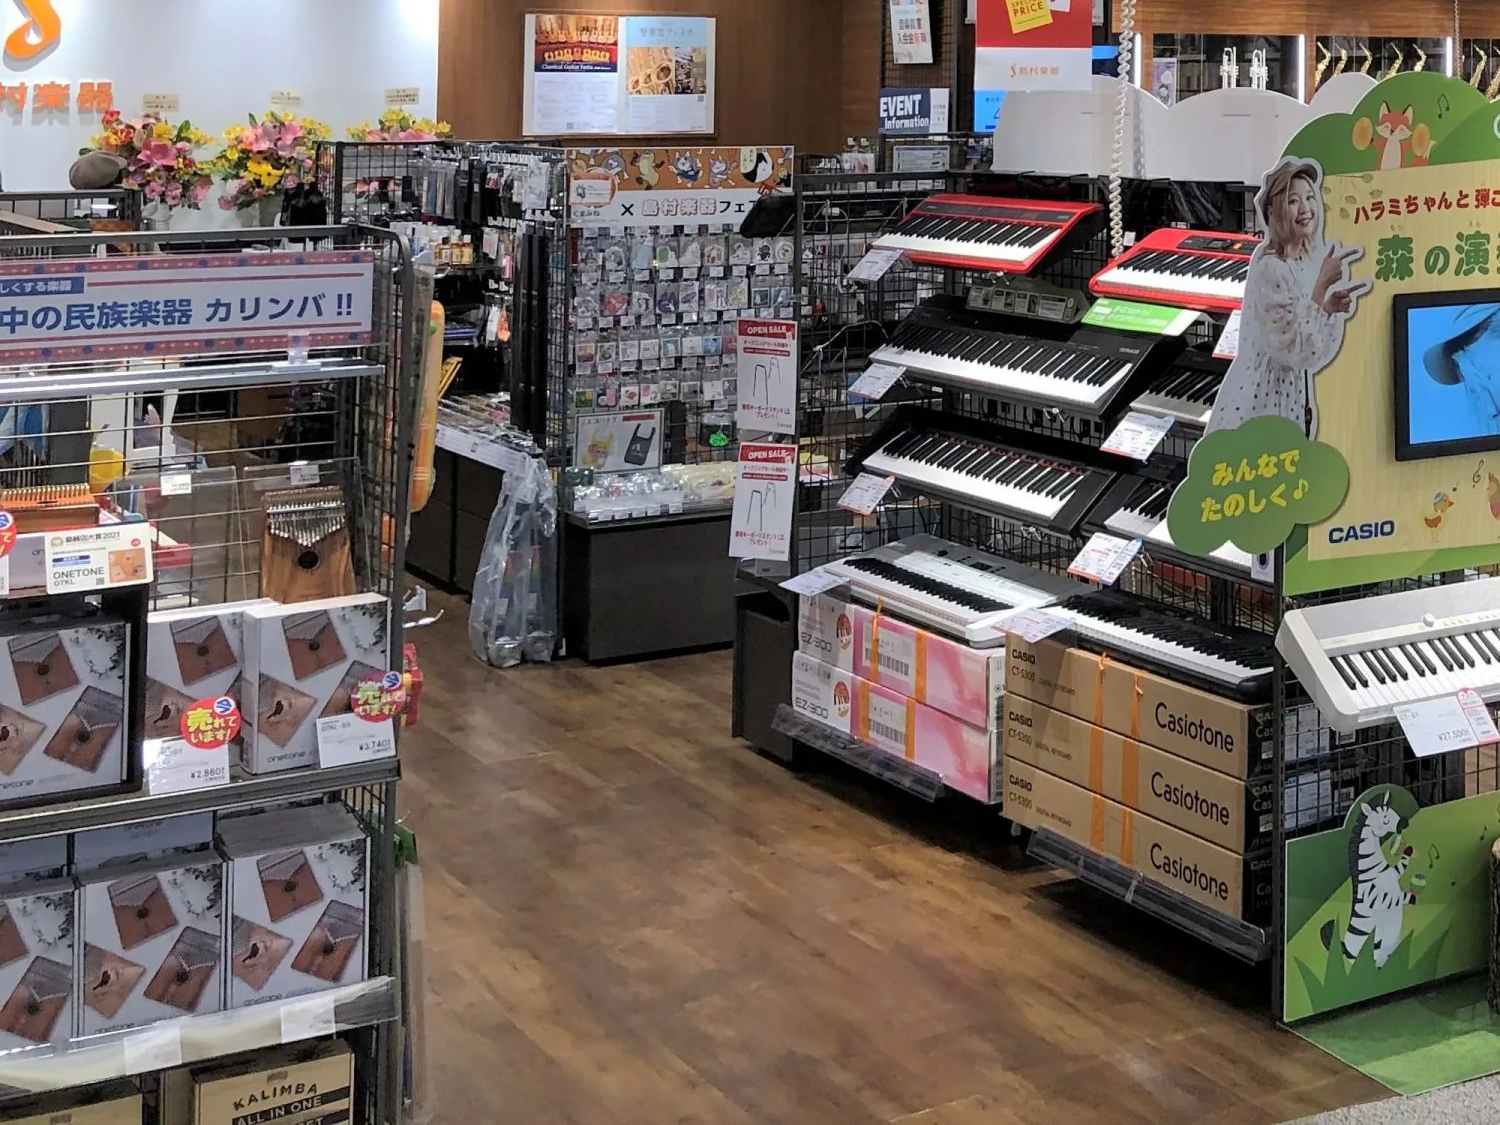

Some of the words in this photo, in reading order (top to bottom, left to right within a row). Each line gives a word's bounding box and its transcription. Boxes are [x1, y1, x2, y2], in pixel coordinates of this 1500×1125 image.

[1013, 1, 1044, 17] PRICE
[880, 94, 922, 117] EVENT
[884, 116, 930, 130] Information
[0, 299, 192, 334] 中の民族楽器
[206, 293, 326, 323] カリンバ
[747, 326, 768, 334] OPEN
[769, 325, 787, 334] SALE
[748, 451, 768, 460] OPEN
[768, 449, 789, 458] SALE
[1212, 449, 1300, 487] みんなで
[1327, 520, 1395, 544] CASIO
[53, 567, 105, 579] ONETONE
[801, 631, 833, 653] EZ-300
[1011, 648, 1036, 665] CASIO
[186, 707, 238, 732] 売れて
[795, 697, 829, 720] EZ-300
[1009, 711, 1033, 728] CASIO
[1155, 702, 1234, 753] Casiotone
[1009, 774, 1033, 792] CASIO
[1151, 771, 1230, 825] Casiotone
[1150, 842, 1229, 901] Casiotone
[232, 1083, 318, 1112] KALIMBA
[270, 1107, 285, 1118] IN
[291, 1096, 322, 1112] ONE
